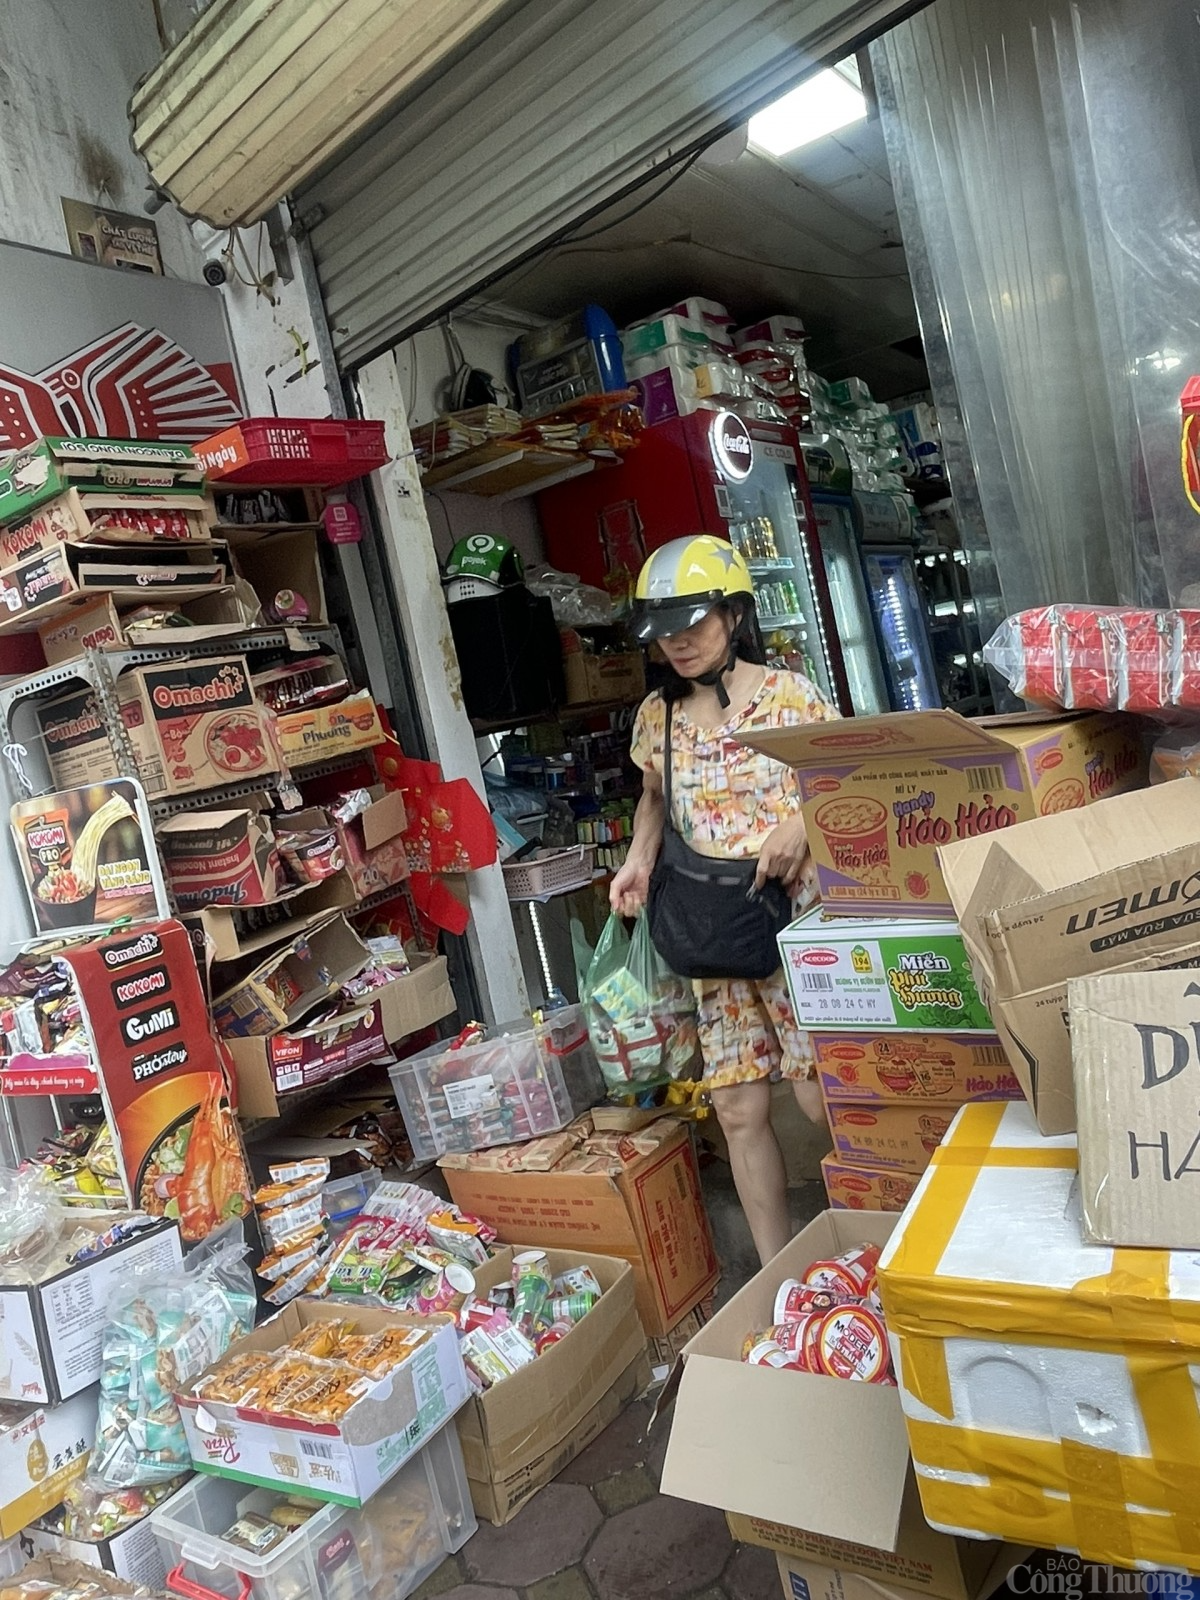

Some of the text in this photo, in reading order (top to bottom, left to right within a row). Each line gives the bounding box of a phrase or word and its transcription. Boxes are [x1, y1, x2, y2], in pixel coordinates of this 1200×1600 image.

[207, 444, 237, 468] Ngày
[2, 516, 50, 557] KOKOMI
[153, 675, 237, 709] Omachi
[906, 784, 917, 794] LY
[893, 790, 936, 818] Handy
[897, 793, 1018, 849] Hảo Hảo
[28, 826, 66, 849] KOKOMI
[40, 848, 60, 863] PRO
[210, 854, 241, 872] Instant
[1033, 915, 1045, 925] 24
[1134, 920, 1166, 937] RỬA
[104, 936, 153, 965] Omachi
[854, 957, 869, 966] 194
[900, 951, 948, 971] Miến
[116, 970, 166, 1002] KOKOMI
[819, 998, 829, 1009] 28
[844, 998, 855, 1009] 24
[1035, 999, 1046, 1008] 24
[126, 1008, 176, 1041] GuMi
[275, 1046, 300, 1059] VIFON
[833, 1319, 876, 1363] MODERN
[201, 1433, 241, 1464] Pizza
[776, 1523, 788, 1535] TY
[908, 1558, 933, 1572] NAM
